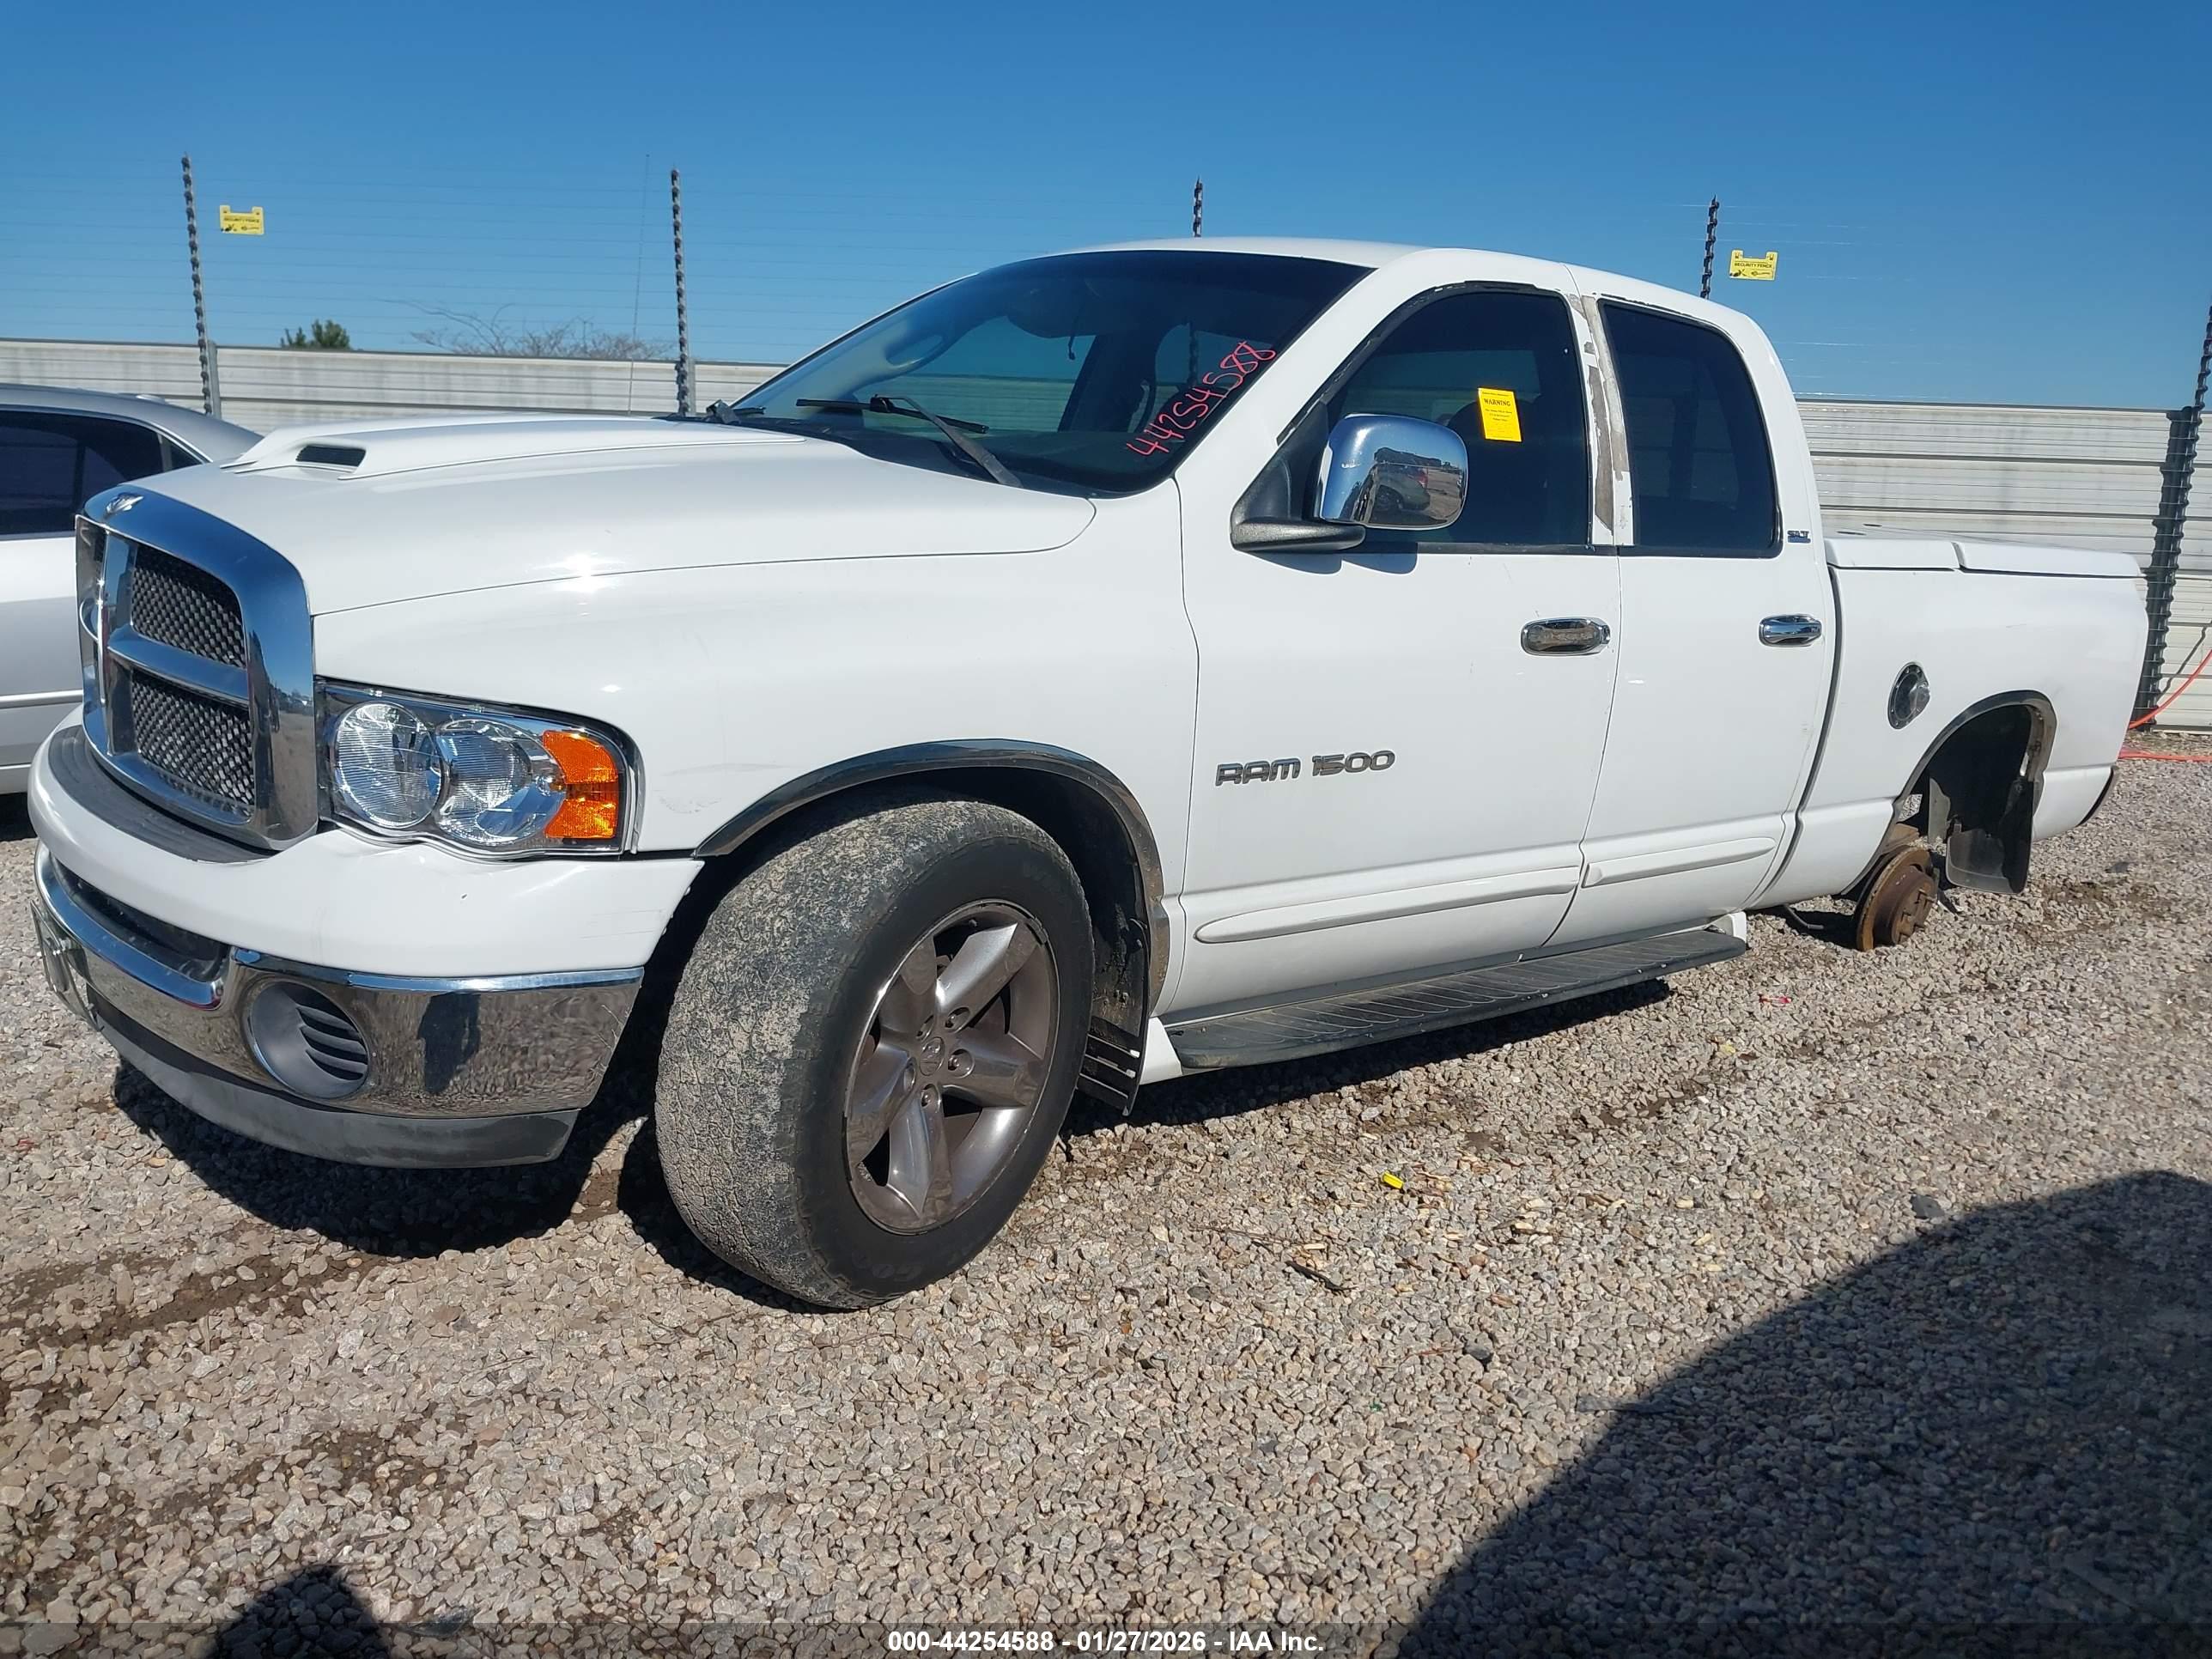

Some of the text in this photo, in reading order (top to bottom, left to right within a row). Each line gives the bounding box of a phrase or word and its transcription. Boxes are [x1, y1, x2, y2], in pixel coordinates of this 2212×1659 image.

[1127, 340, 1276, 456] 44254588
[1483, 398, 1511, 406] WARNING
[1215, 750, 1395, 787] RAM 1500
